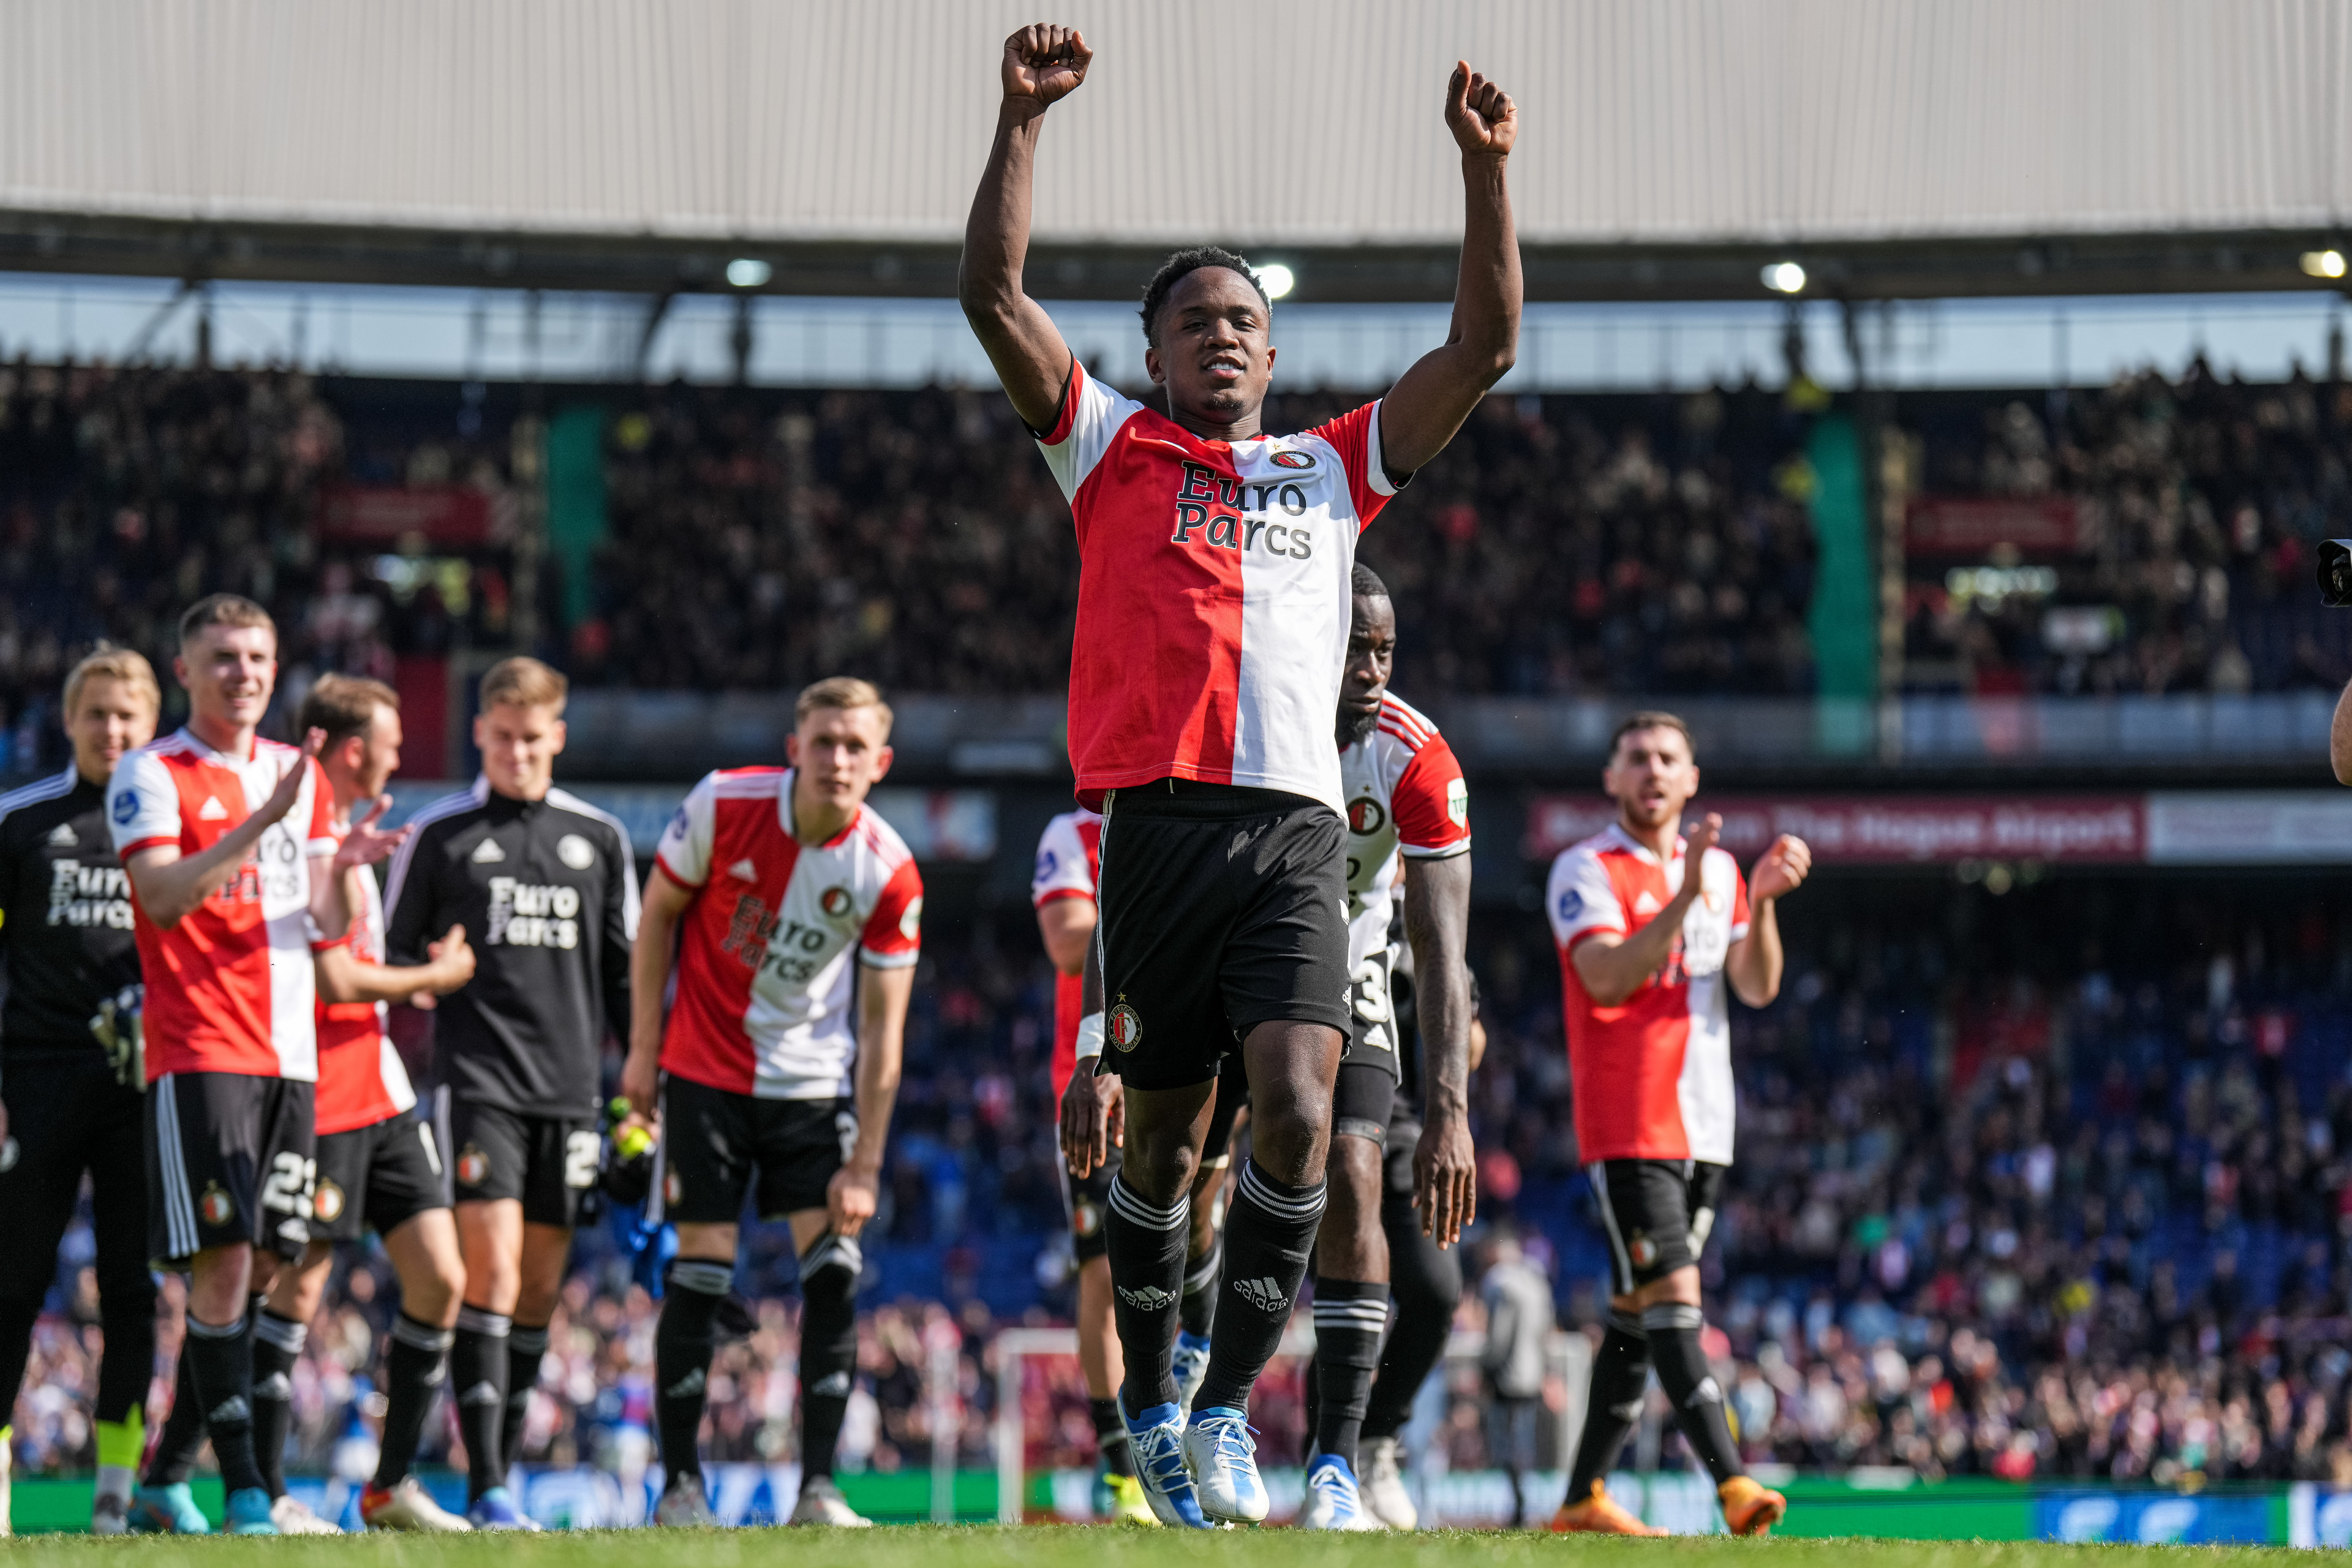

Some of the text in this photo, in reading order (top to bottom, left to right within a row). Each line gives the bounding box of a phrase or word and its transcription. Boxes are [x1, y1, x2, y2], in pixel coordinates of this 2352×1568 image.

[1177, 460, 1307, 516] Euro
[1171, 502, 1311, 560] Parcs
[488, 876, 579, 919] Euro
[484, 905, 578, 949] Parcs
[733, 894, 827, 953] Euro
[1110, 1006, 1139, 1022] FEYENOORD
[1110, 1033, 1140, 1050] ROTTERDAM
[1117, 1286, 1176, 1311] adidas
[1234, 1281, 1289, 1312] adidas
